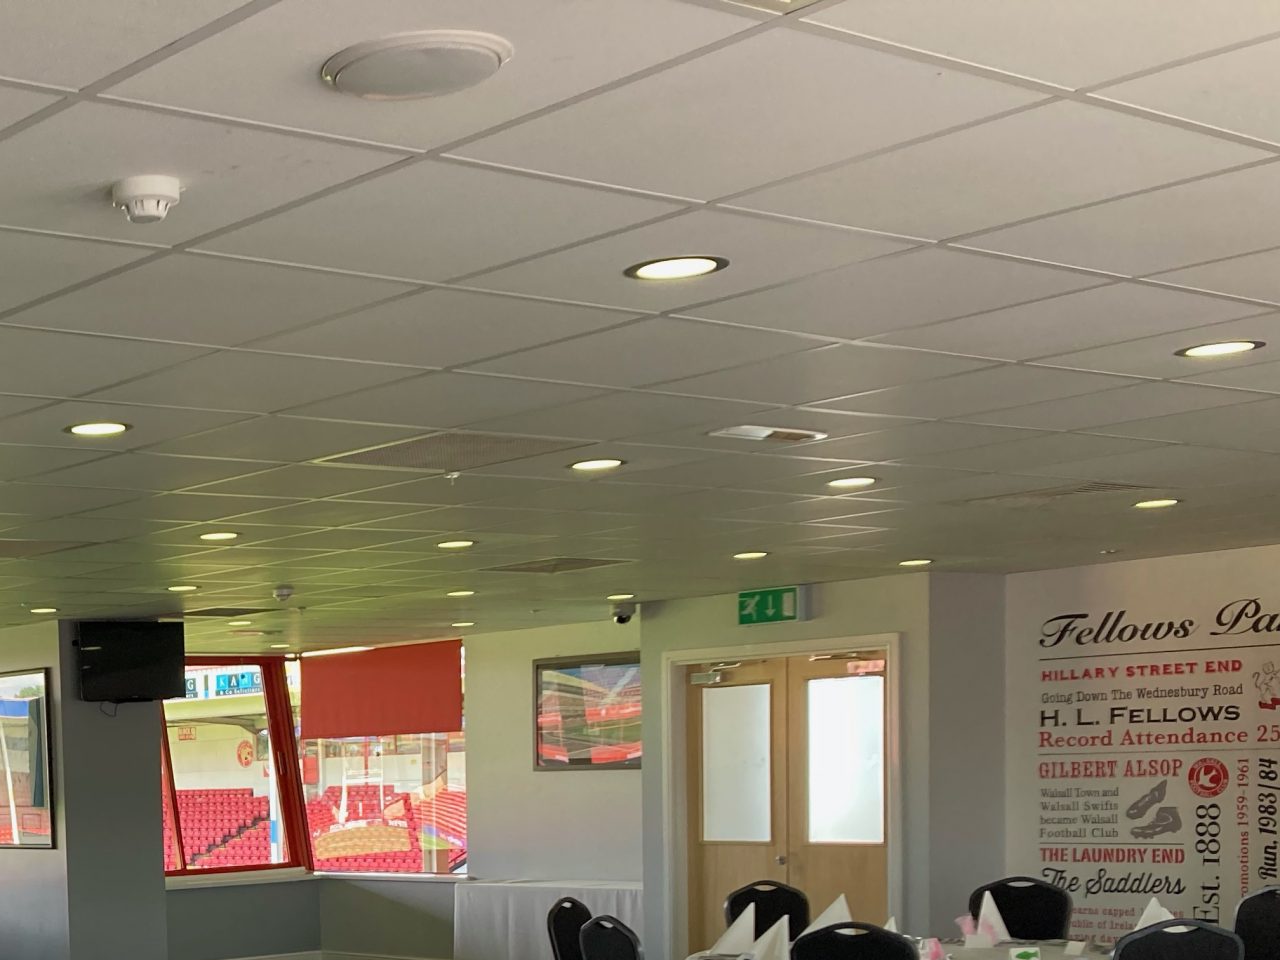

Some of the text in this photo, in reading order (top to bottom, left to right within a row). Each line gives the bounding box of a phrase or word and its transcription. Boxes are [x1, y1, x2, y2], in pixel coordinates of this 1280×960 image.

[1039, 598, 1280, 648] Fellows Pa
[1041, 659, 1243, 682] HILLARY STREET END
[1041, 683, 1243, 704] Going Down The Wednesbury Road
[1040, 705, 1241, 727] H. L. FELLOWS
[1039, 729, 1113, 748] Record
[1121, 727, 1248, 746] Attendance
[1039, 759, 1183, 779] GILBERT ALSOP
[1040, 787, 1119, 798] Walsall Town and
[1040, 800, 1119, 812] Walsall Swifts
[1040, 814, 1118, 825] became Walsall
[1039, 828, 1119, 839] Football Club
[1195, 803, 1221, 867] 1888
[1040, 847, 1185, 864] THE LAUNDRY END
[1238, 831, 1250, 898] romotions
[1042, 867, 1186, 899] The Saddlers
